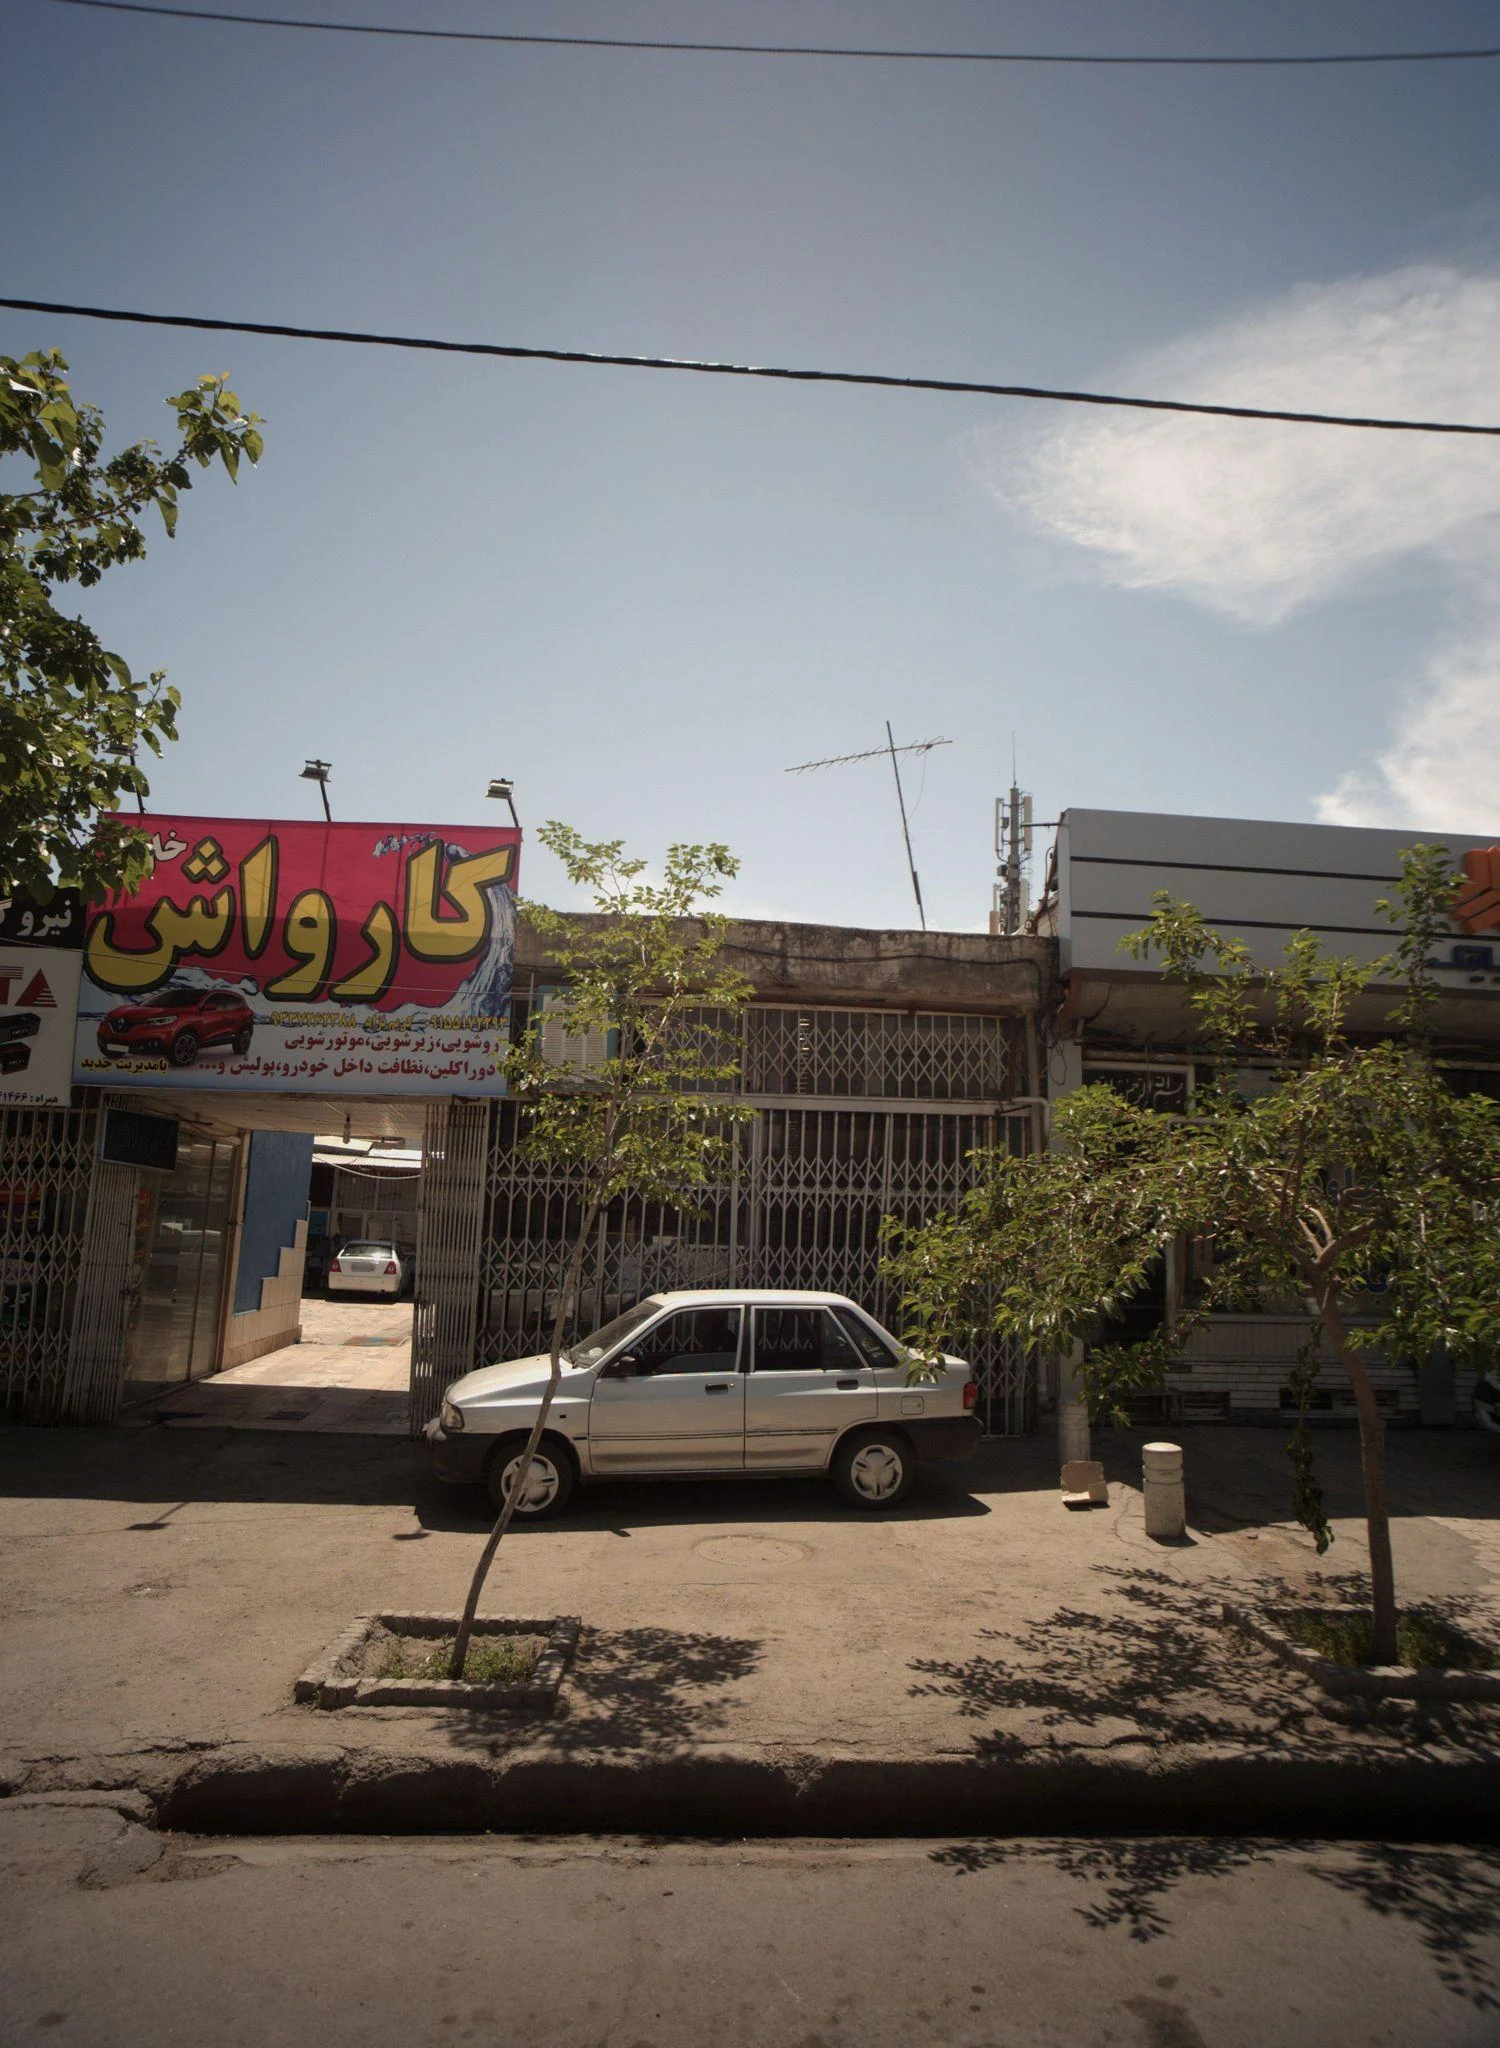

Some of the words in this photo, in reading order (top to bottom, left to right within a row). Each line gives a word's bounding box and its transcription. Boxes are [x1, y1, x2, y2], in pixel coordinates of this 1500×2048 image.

[16, 899, 73, 937] نیرو
[83, 835, 515, 1000] کارواش
[333, 1057, 373, 1078] داخل
